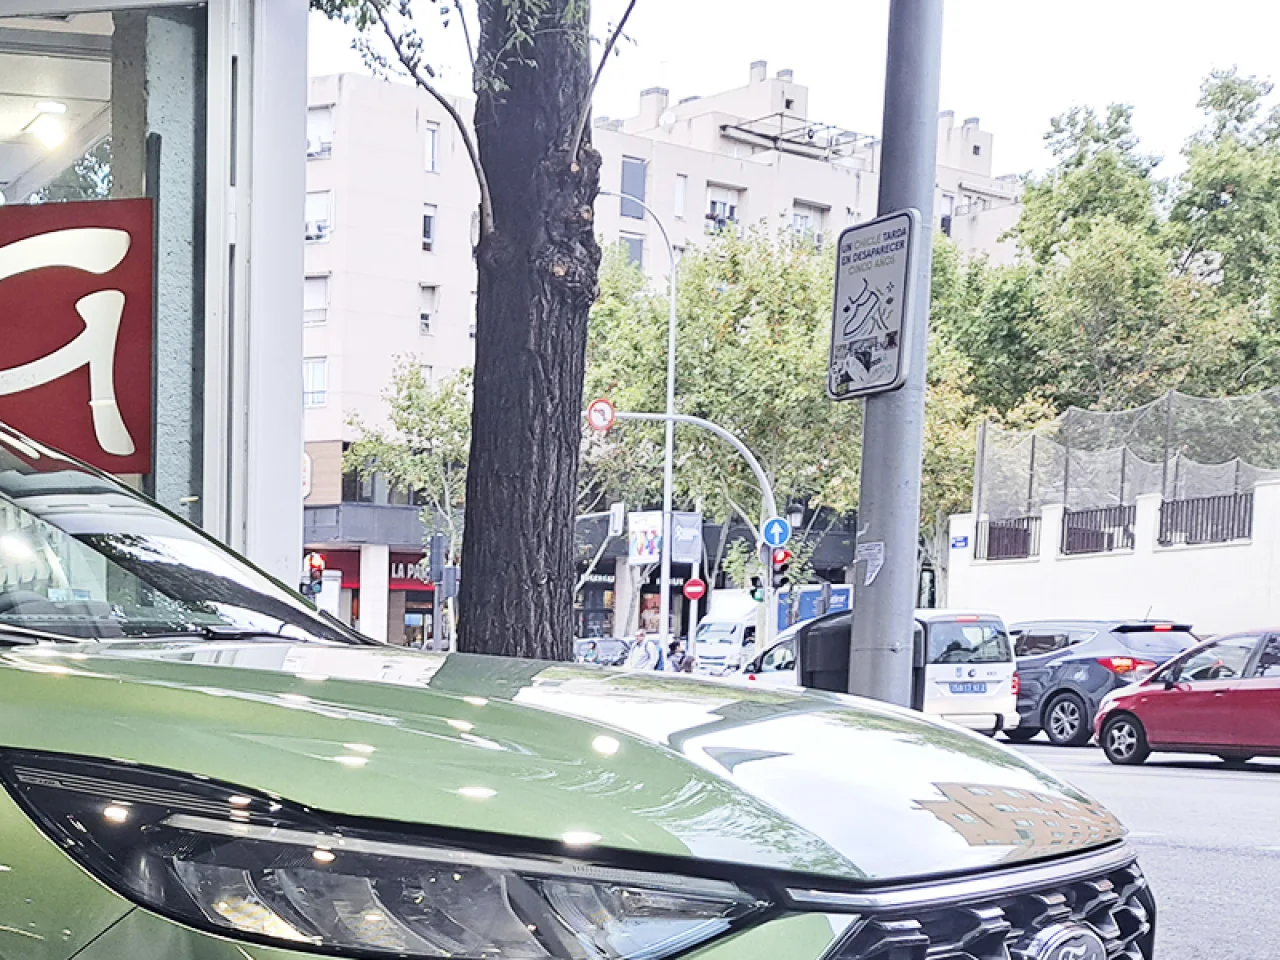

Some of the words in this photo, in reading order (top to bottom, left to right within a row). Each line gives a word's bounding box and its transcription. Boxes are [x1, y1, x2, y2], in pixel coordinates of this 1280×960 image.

[883, 227, 906, 241] TARDA
[841, 255, 851, 266] EN
[853, 240, 905, 262] DESAPARECER
[391, 562, 405, 578] LA
